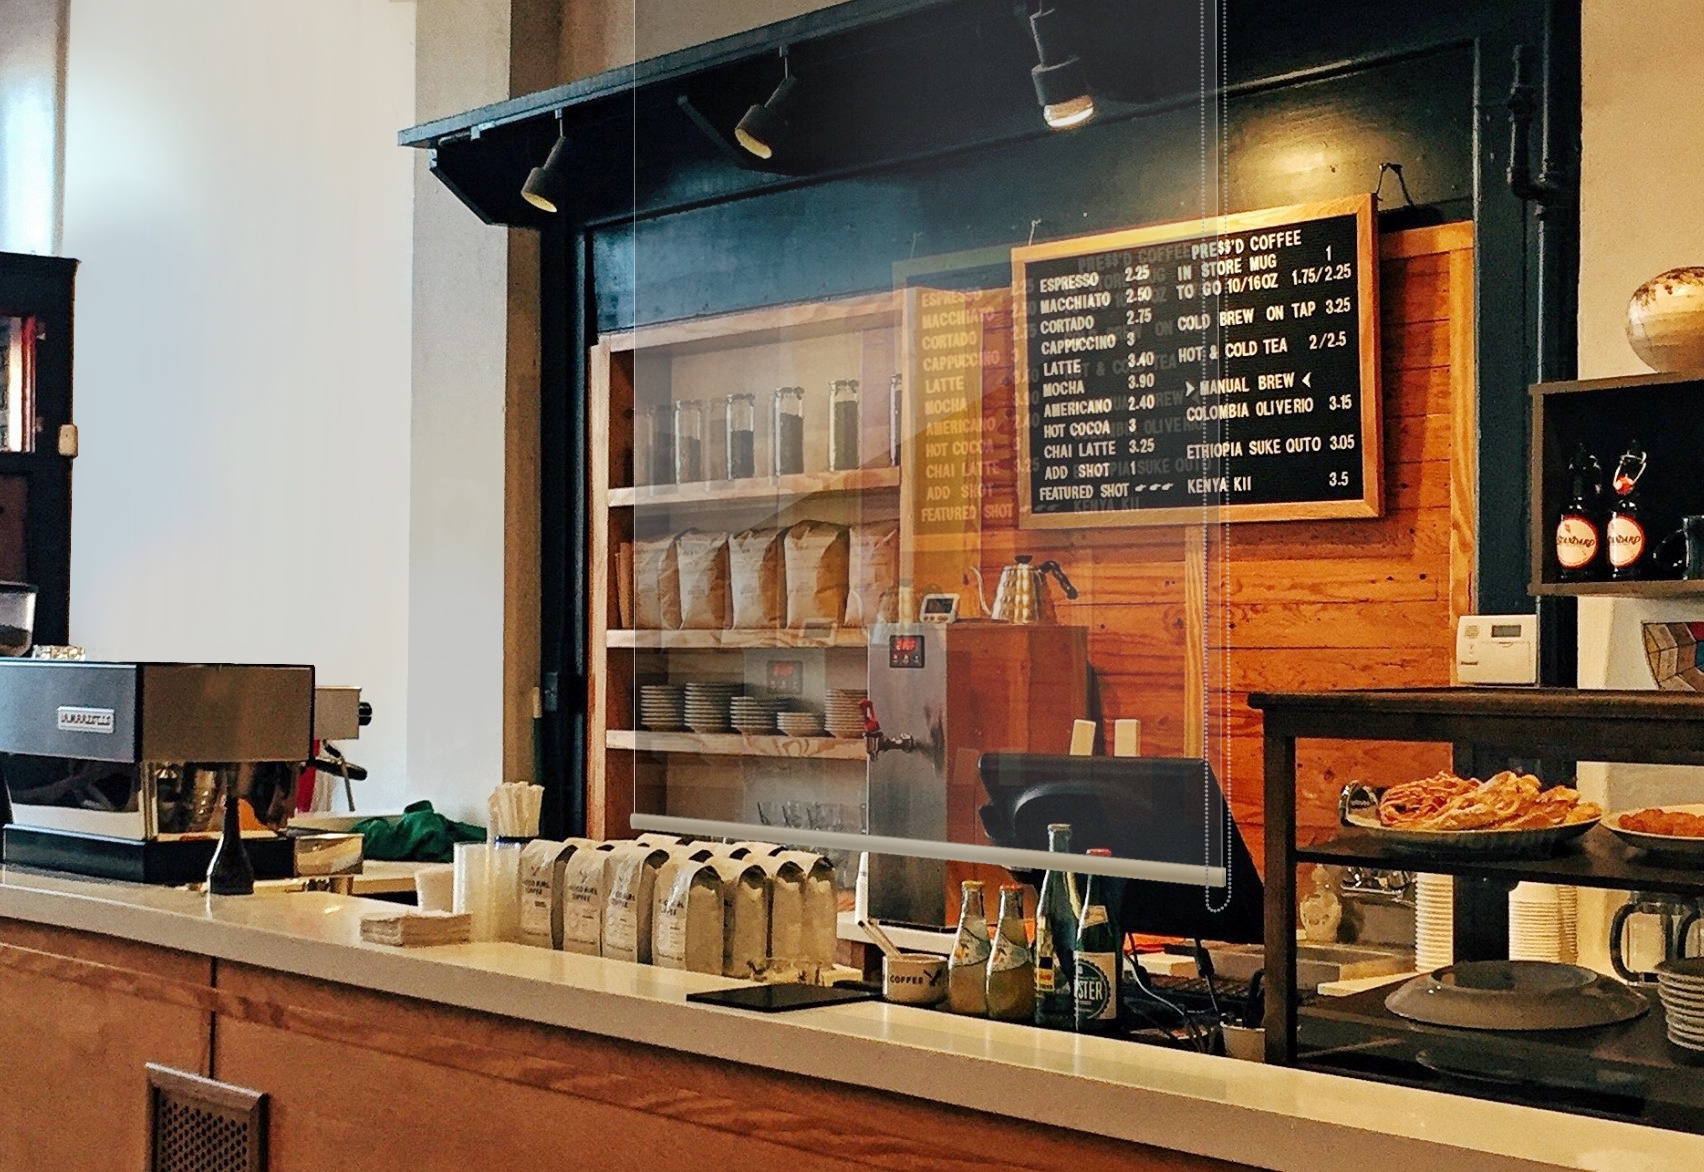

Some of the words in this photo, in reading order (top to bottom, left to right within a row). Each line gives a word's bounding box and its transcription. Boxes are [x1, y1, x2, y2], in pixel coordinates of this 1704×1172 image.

[1250, 229, 1302, 251] COFFEE
[1177, 265, 1192, 282] IN
[1201, 257, 1243, 279] STORE
[1250, 254, 1277, 272] MUG
[1325, 245, 1332, 261] 1
[1040, 272, 1099, 293] ESPRESSO
[1124, 264, 1150, 282] 2.25
[1176, 284, 1194, 300] TO
[1202, 280, 1222, 297] GO
[1227, 272, 1278, 294] 10/16OZ
[1040, 291, 1111, 314] MACCHIATO
[1125, 286, 1152, 303] 2.50
[922, 307, 995, 330] MACCHIATO
[1040, 315, 1095, 334] CORTADO
[1126, 308, 1152, 325] 2.75
[1177, 313, 1211, 331] COLD
[1219, 307, 1255, 327] BREW
[1266, 305, 1284, 321] ON
[1291, 301, 1316, 319] TAP
[1325, 297, 1351, 314] 3.25
[922, 331, 977, 350] CORTADO
[1041, 334, 1116, 355] CAPPUCCINO
[1126, 332, 1135, 346] 3
[1178, 346, 1203, 363] HOT
[1209, 345, 1218, 360] &
[1225, 340, 1258, 358] COLD
[1263, 338, 1288, 355] TEA
[923, 350, 1000, 371] CAPPUCCINO
[1043, 359, 1081, 377] LATTE
[1127, 351, 1154, 368] 3.40
[925, 375, 964, 394] LATTE
[1042, 380, 1085, 397] MOCHA
[1128, 373, 1155, 390] 3.90
[1200, 376, 1250, 396] MANUAL
[1258, 372, 1295, 390] BREW
[925, 397, 968, 415] MOCHA
[1044, 398, 1112, 418] AMERICANO
[1128, 394, 1155, 411] 2.40
[1186, 402, 1250, 422] COLOMBIA
[1256, 397, 1314, 417] OLIVERIO
[926, 417, 996, 437] AMERICANO
[1044, 423, 1066, 438] HOT
[1069, 419, 1111, 437] COCOA
[1128, 418, 1136, 432] 3
[925, 443, 949, 458] HOT
[1044, 444, 1072, 459] CHAI
[1079, 441, 1116, 457] LATTE
[1129, 438, 1155, 454] 3.25
[1186, 441, 1243, 460] ETHIOPIA
[1249, 438, 1281, 456] SUKE
[1329, 434, 1355, 451] 3.05
[926, 463, 955, 478] CHAI
[1045, 465, 1068, 480] ADD
[1078, 463, 1111, 478] SHOT
[1130, 461, 1136, 476] 1
[926, 486, 951, 501] ADD
[1039, 484, 1093, 501] FEATURED
[1100, 482, 1130, 498] SHOT
[1187, 476, 1228, 494] KENYA
[1234, 475, 1252, 492] KII
[1329, 471, 1349, 487] 3.5
[922, 505, 977, 522] FEATURED
[984, 503, 1014, 519] SHOT
[890, 974, 923, 985] COFFEE
[1077, 980, 1103, 1001] STER
